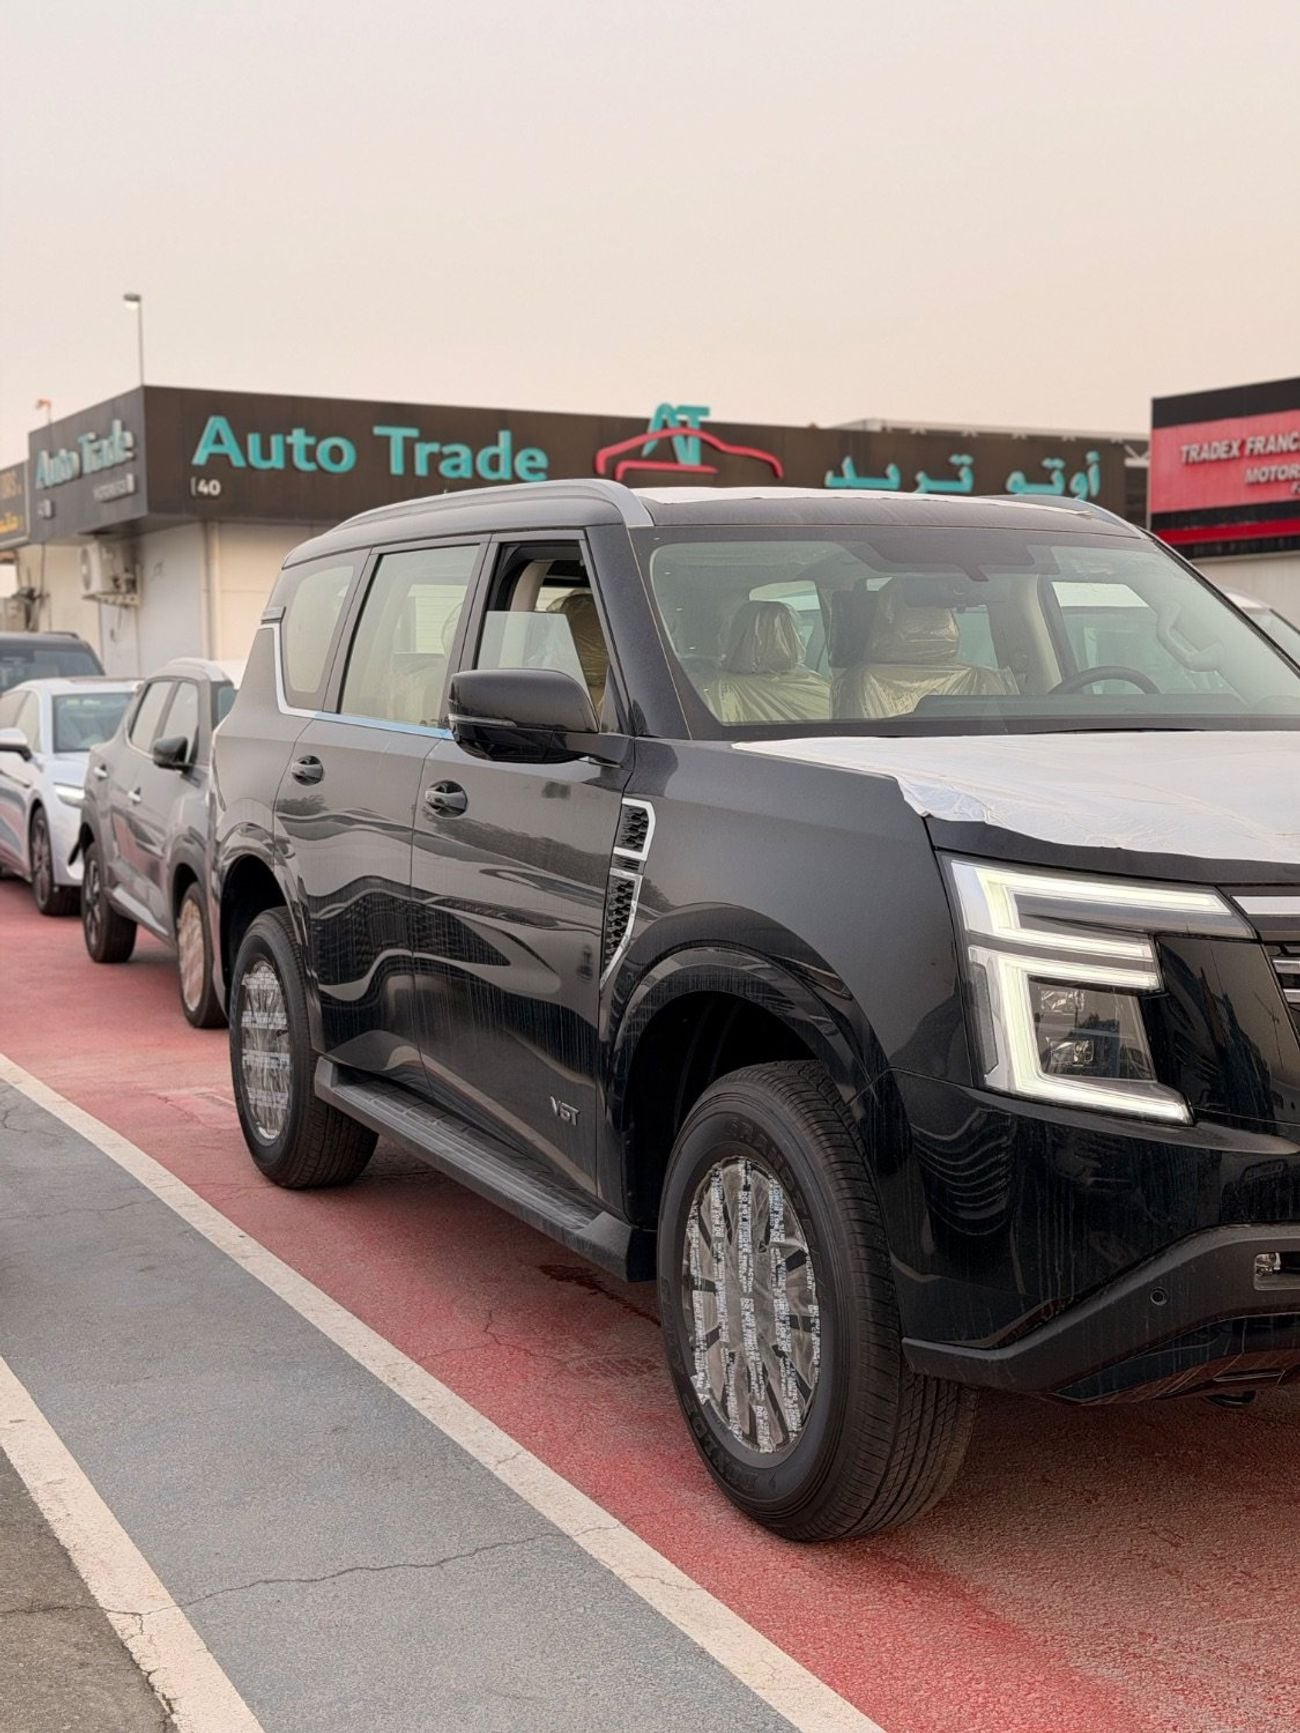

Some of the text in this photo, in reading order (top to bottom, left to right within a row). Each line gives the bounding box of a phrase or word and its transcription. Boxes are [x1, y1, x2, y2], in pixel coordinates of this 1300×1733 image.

[191, 415, 549, 482] Auto Trade
[1181, 432, 1300, 465] TRADEX FRANC
[1244, 464, 1300, 485] MOTOR
[550, 1096, 579, 1126] V6T
